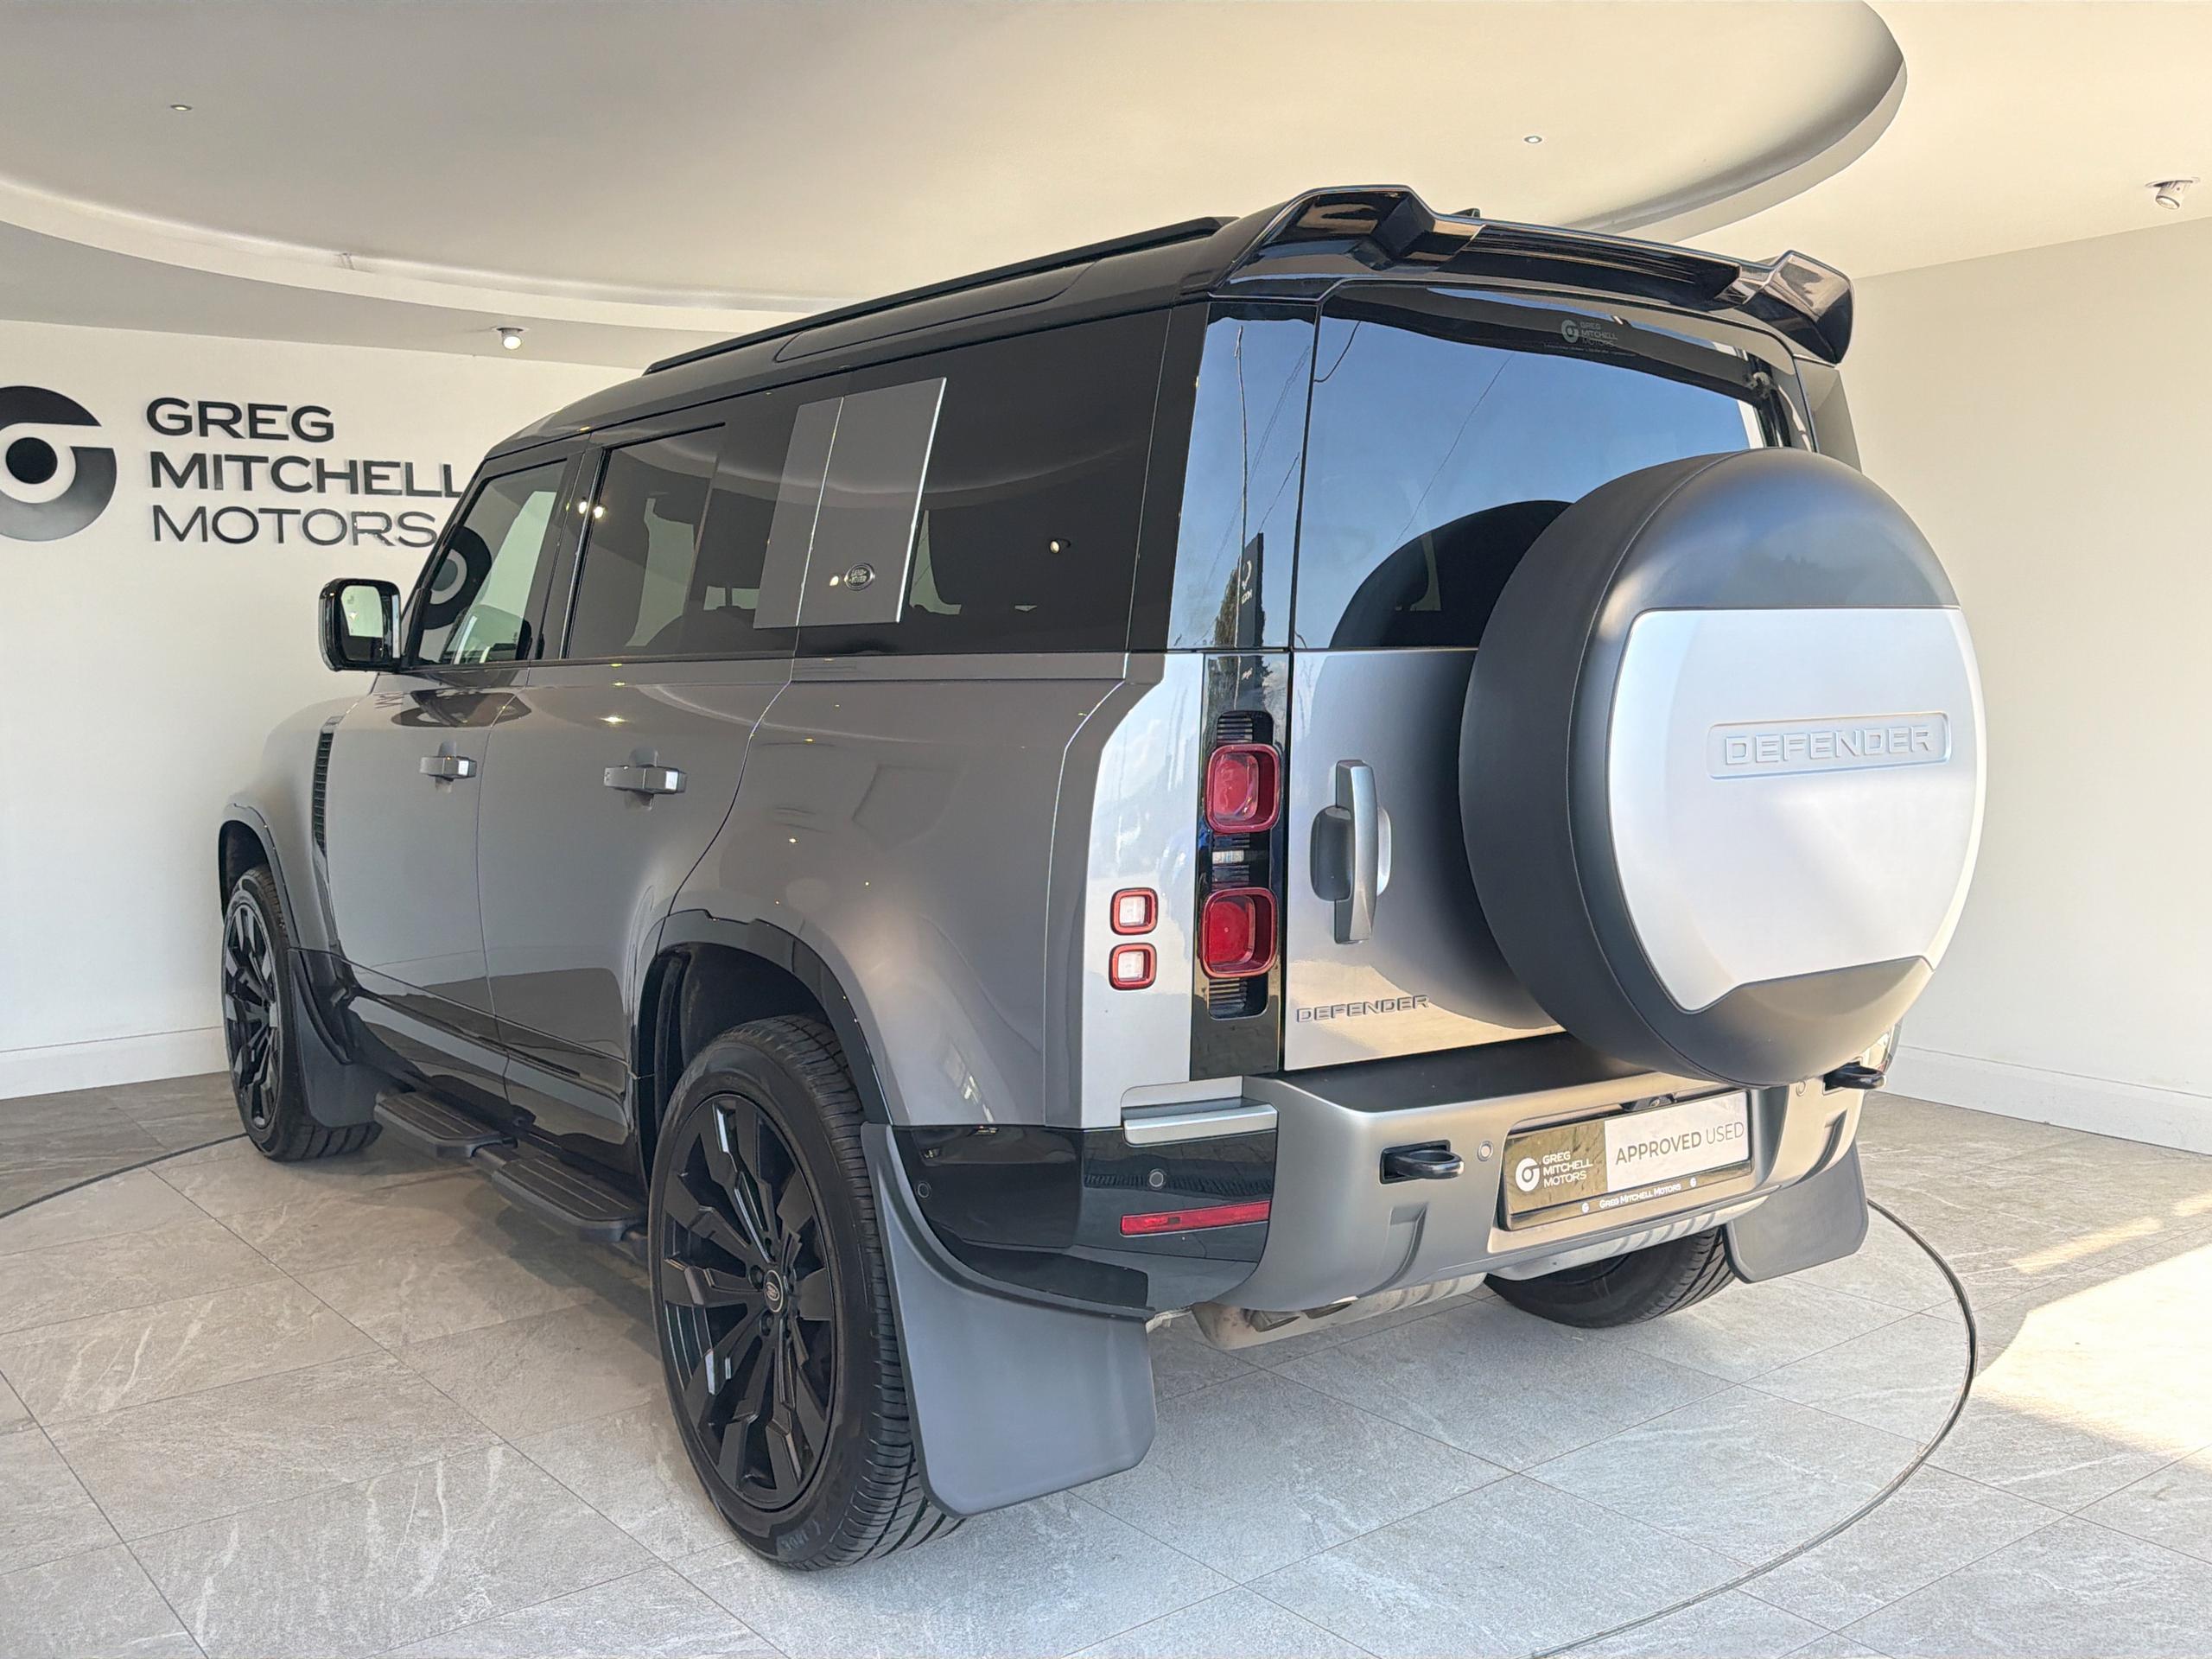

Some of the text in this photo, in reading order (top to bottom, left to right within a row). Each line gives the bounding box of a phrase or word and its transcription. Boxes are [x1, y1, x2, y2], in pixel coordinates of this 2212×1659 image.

[1580, 321, 1601, 331] GREG
[1580, 328, 1618, 340] MITCHELL
[146, 397, 335, 443] GREG
[150, 451, 462, 499] MITCHELL
[152, 505, 438, 549] MOTORS
[1725, 724, 1931, 766] DEFENDER
[1296, 995, 1430, 1023] DEFENDER
[1542, 1151, 1571, 1165] GREG
[1615, 1122, 1745, 1166] APPROVED USED
[1543, 1158, 1593, 1177] MITCHELL
[1543, 1170, 1587, 1188] MOTORS
